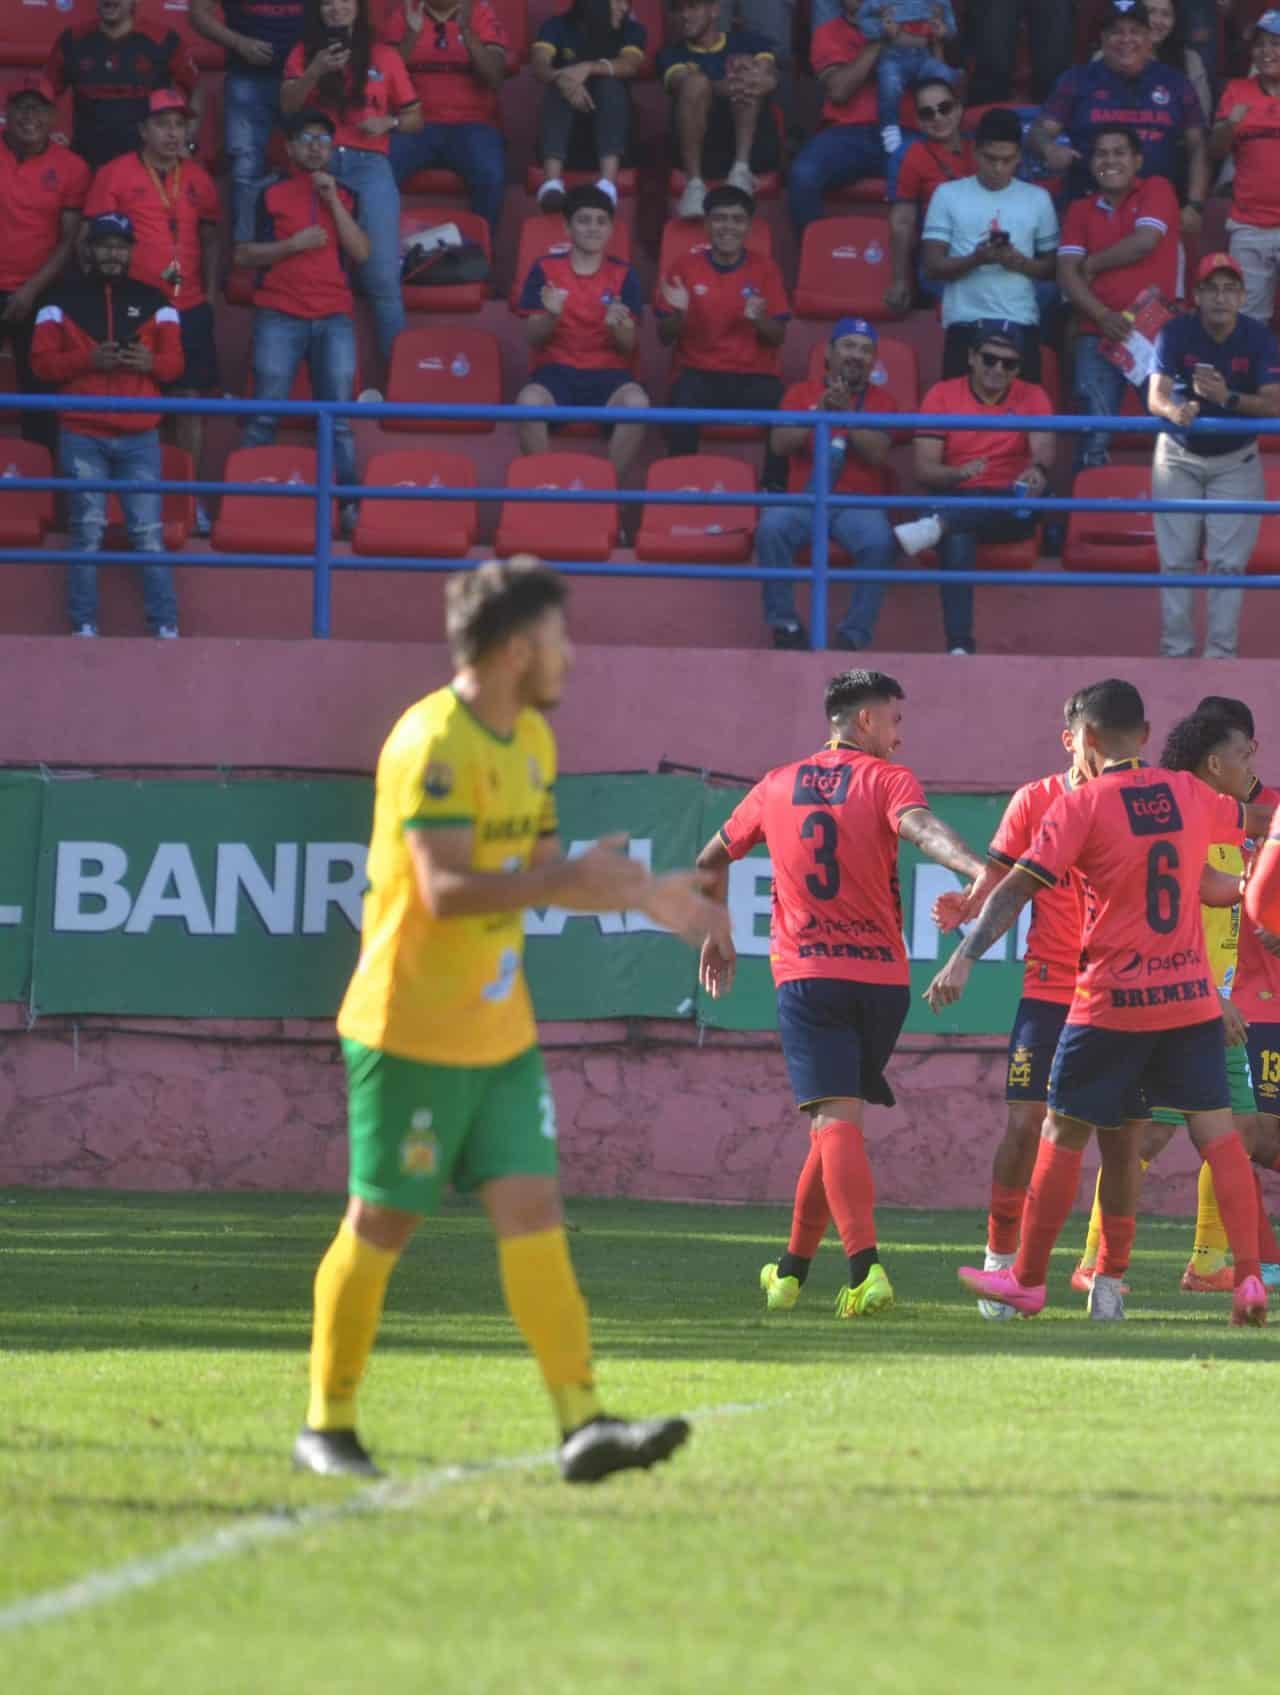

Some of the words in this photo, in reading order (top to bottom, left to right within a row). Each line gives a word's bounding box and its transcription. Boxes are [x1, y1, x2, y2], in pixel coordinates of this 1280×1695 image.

[802, 772, 841, 793] tigo
[1132, 794, 1172, 819] tigo
[801, 811, 840, 900] 3
[1145, 841, 1181, 934] 6
[1111, 977, 1210, 1009] BREMEN
